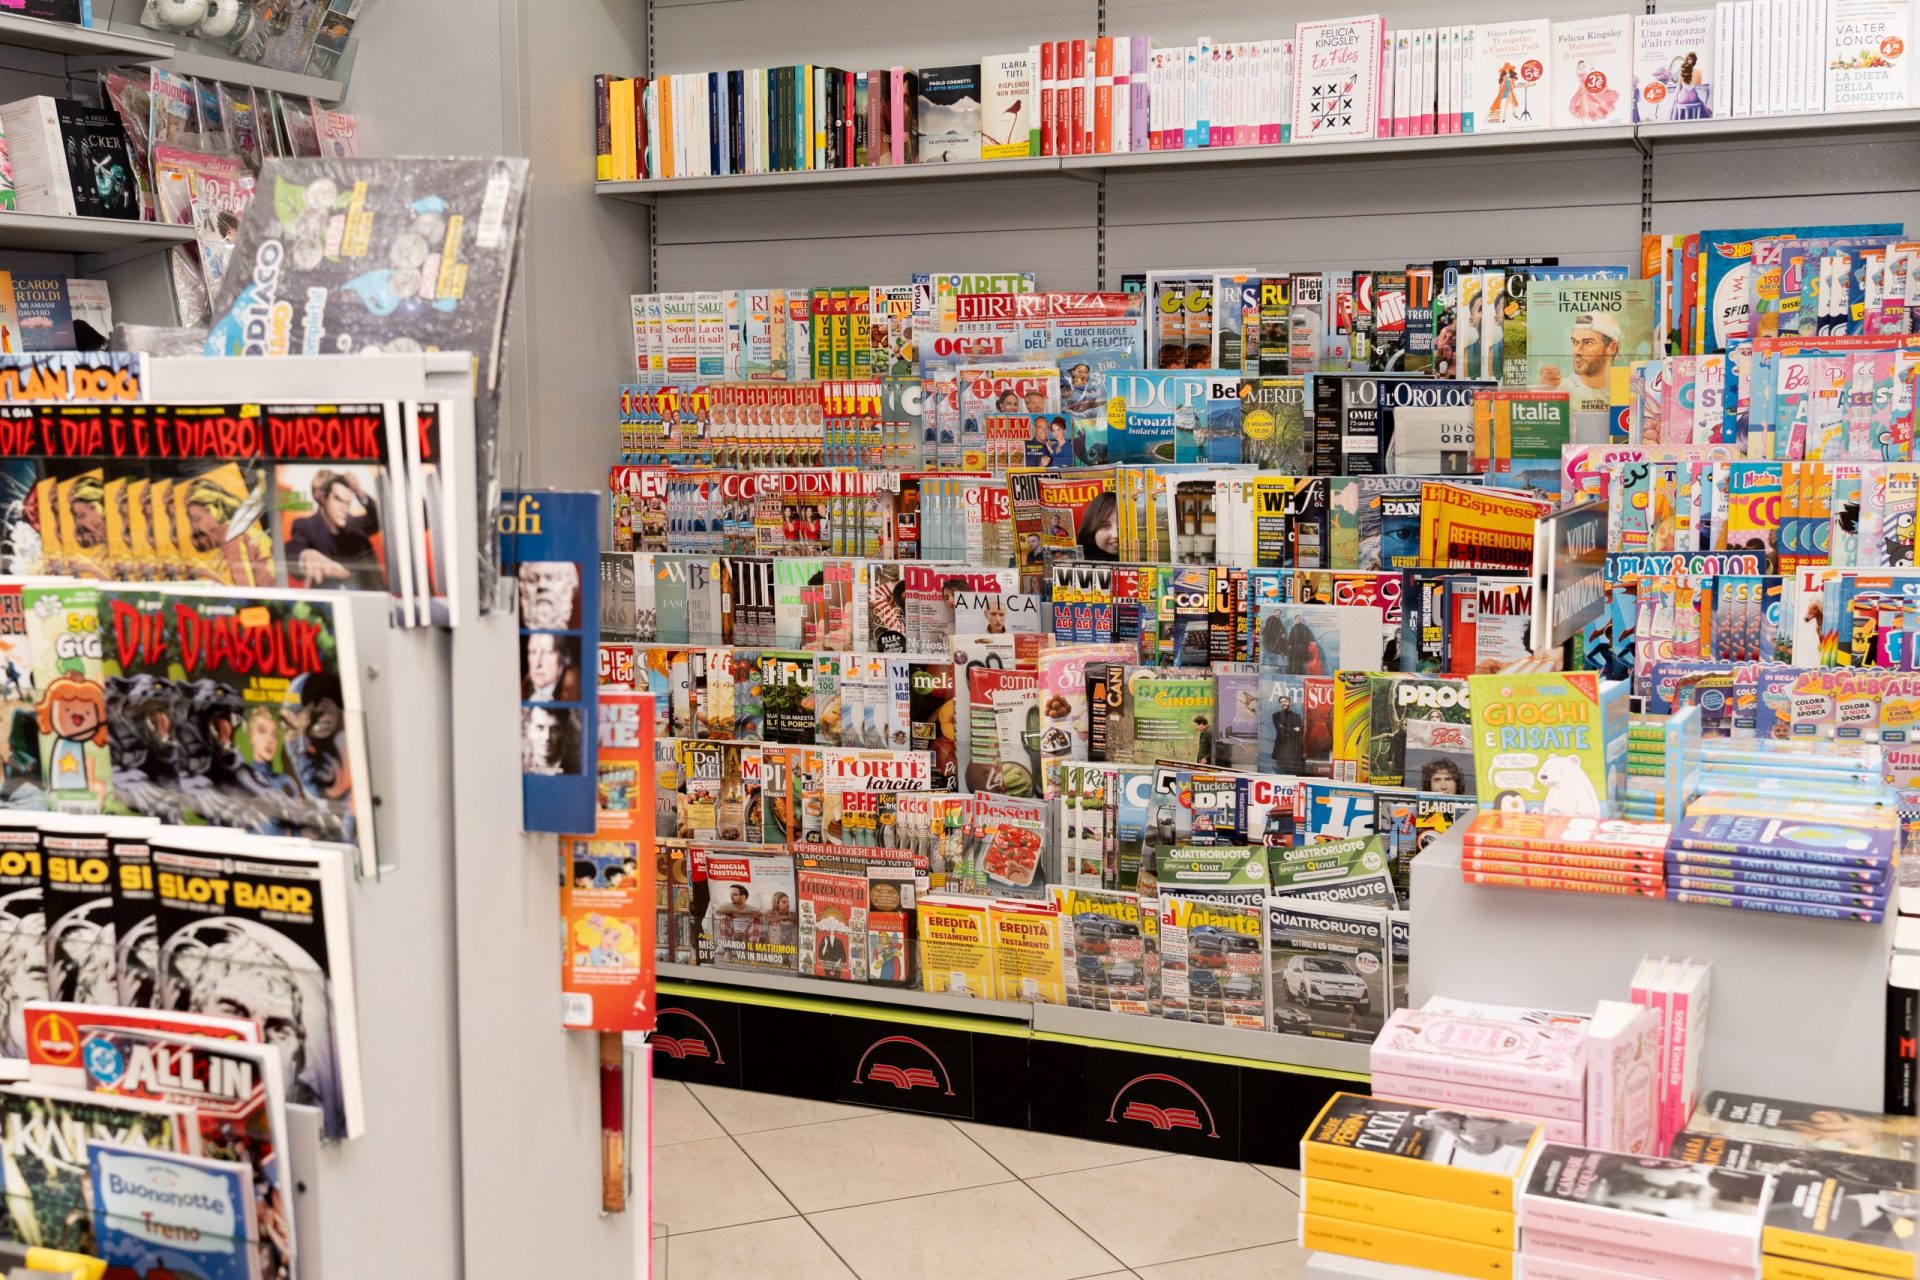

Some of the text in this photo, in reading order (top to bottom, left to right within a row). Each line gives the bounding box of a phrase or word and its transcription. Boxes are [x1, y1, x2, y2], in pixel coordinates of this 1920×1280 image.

[1641, 15, 1707, 27] Felicia Kingsley
[1321, 28, 1355, 38] FELICIA
[1487, 28, 1536, 37] Felicia Kingsley
[1641, 27, 1706, 39] Una ragazza
[1836, 23, 1885, 34] VALTER
[1504, 36, 1531, 46] aspetto
[1558, 29, 1622, 43] Felicia Kingsley
[1315, 36, 1359, 48] KINGSLEY
[1569, 40, 1612, 50] Matrimonio
[1641, 36, 1705, 48] d'altri tempi
[1312, 48, 1359, 70] Ex Files
[1571, 48, 1616, 60] convenienza
[1001, 61, 1027, 69] ILARIA
[1006, 70, 1023, 78] TUTI
[1835, 71, 1889, 81] LA DIETA
[998, 81, 1029, 89] RISPLENDO
[1835, 83, 1873, 92] DELLA
[1835, 92, 1904, 103] LONGEVITÀ
[1559, 291, 1621, 301] IL TENNIS
[1048, 295, 1107, 315] RIZA
[1559, 302, 1622, 312] ITALIANO
[1075, 328, 1095, 336] DIECI
[1097, 328, 1127, 336] REGOLE
[1056, 336, 1136, 348] DELLA FELICITÀ
[1512, 403, 1560, 421] Italia
[1009, 418, 1029, 428] TV
[269, 417, 381, 458] DIABOLIK
[1008, 430, 1031, 438] MIA
[1450, 524, 1532, 550] REFERENDUM
[1480, 547, 1532, 564] GIUGNO
[1617, 554, 1760, 577] PLAY & COLOR
[174, 602, 322, 676] DIABOLIK
[818, 682, 833, 690] 100
[1795, 698, 1825, 706] COLORA
[1840, 702, 1870, 710] COLORA
[1482, 701, 1588, 726] GIOCHI
[1797, 709, 1826, 717] SPORCA
[1841, 713, 1871, 722] SPORCA
[1485, 726, 1590, 750] E RISATE
[976, 801, 1041, 822] Dessert
[794, 844, 825, 855] IMPARA
[826, 846, 833, 854] A
[834, 847, 870, 857] LEGGERE
[878, 849, 913, 859] FUTURO
[1170, 849, 1250, 860] QUATTRORUOTE
[1283, 841, 1366, 862] QUATTRORUOTE
[801, 854, 838, 862] TAROCCHI
[849, 857, 884, 865] RIVELANO
[709, 870, 748, 878] CRISTIANA
[1279, 865, 1305, 873] SPECIALE
[929, 916, 977, 930] EREDITÀ
[1270, 912, 1379, 937] QUATTRORUOTE
[1000, 923, 1048, 936] EREDITÀ
[931, 932, 978, 942] TESTAMENTO
[718, 939, 746, 950] QUANDO
[1001, 938, 1049, 949] TESTAMENTO
[736, 950, 783, 964] VA IN BIANCO
[124, 1045, 251, 1098] ALL IN
[1355, 1109, 1411, 1150] TATÀ
[109, 1174, 225, 1214] Buonanotte
[141, 1212, 200, 1241] Treno
